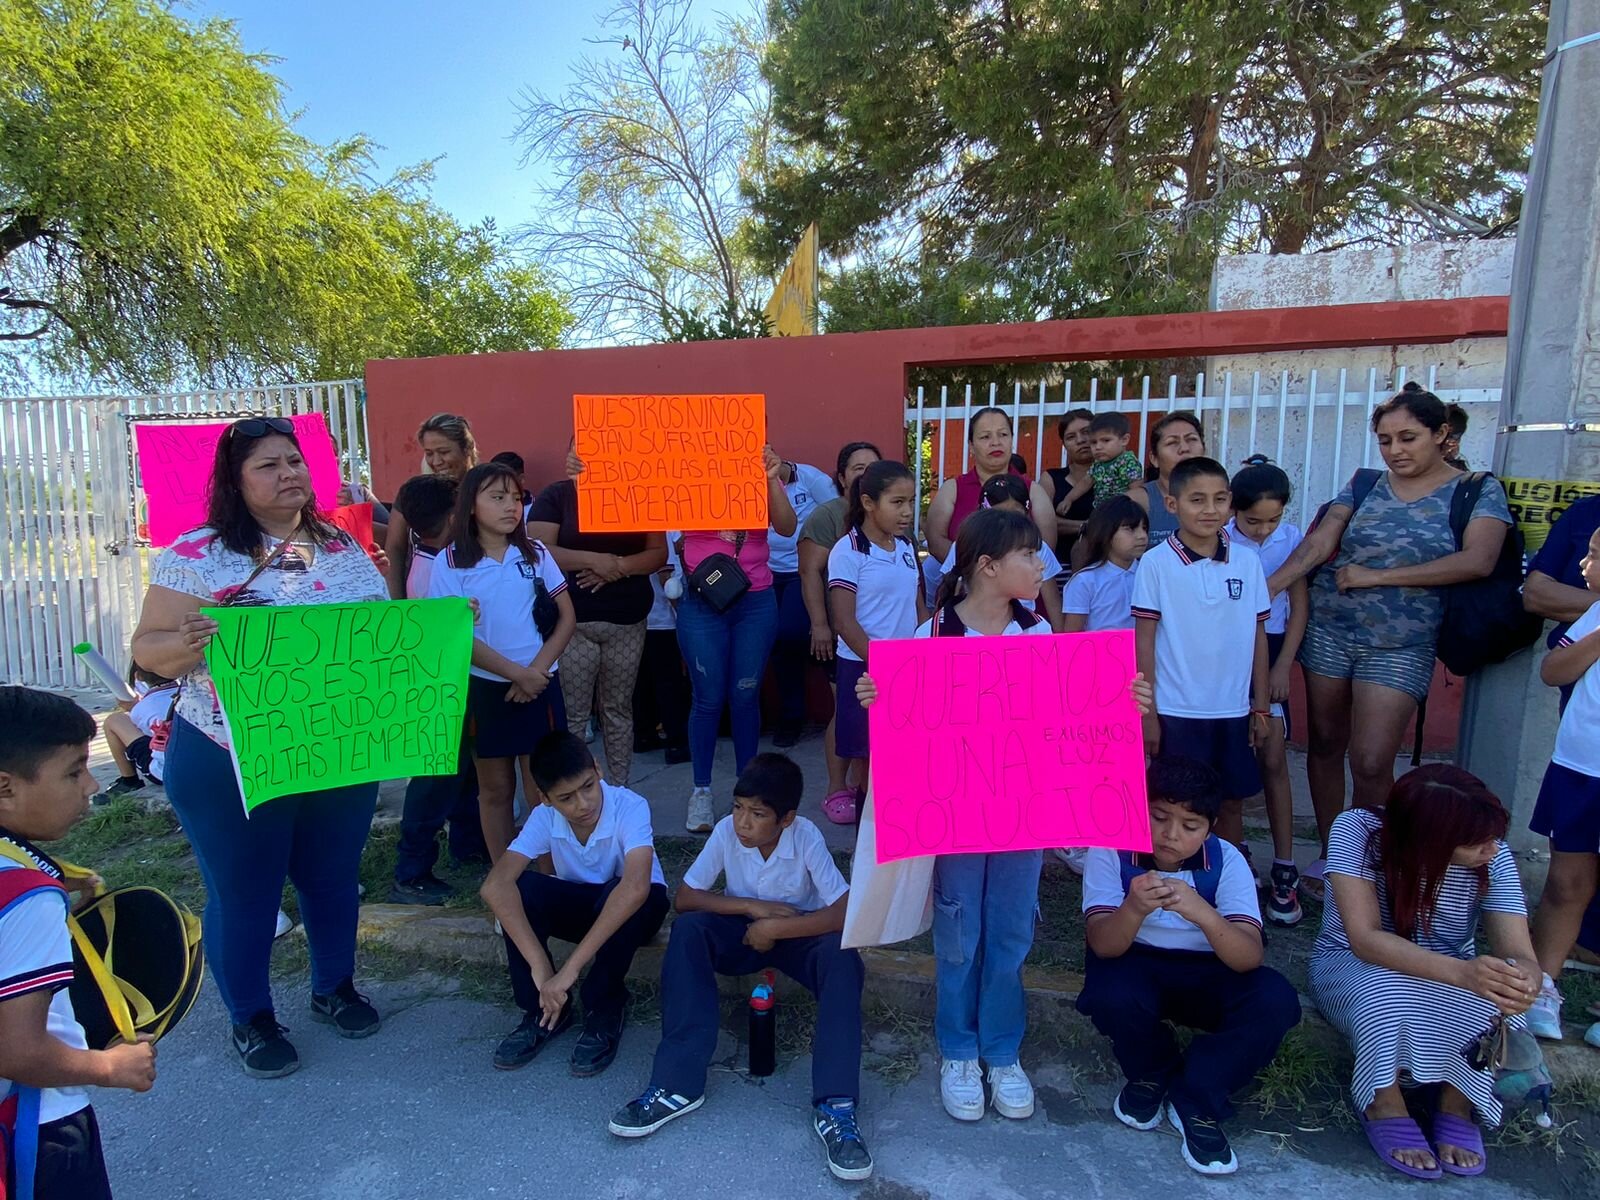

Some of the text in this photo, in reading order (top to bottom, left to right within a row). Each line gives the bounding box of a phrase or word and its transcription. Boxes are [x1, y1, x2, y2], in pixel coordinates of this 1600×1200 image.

[577, 396, 754, 429] NUESTROS NIÑOS
[577, 429, 758, 456] ESTAN SUFRIENDO
[579, 456, 765, 486] DEBIDO A LAS ALTAS
[579, 482, 766, 525] TEMPERATURAS
[210, 604, 424, 670] NUESTROS
[324, 650, 442, 700] ESTAN
[887, 634, 1127, 731] QUEREMOS
[405, 684, 460, 717] POR
[926, 729, 1116, 801] UNA LUZ
[882, 775, 1150, 858] SOLUCIÓN
